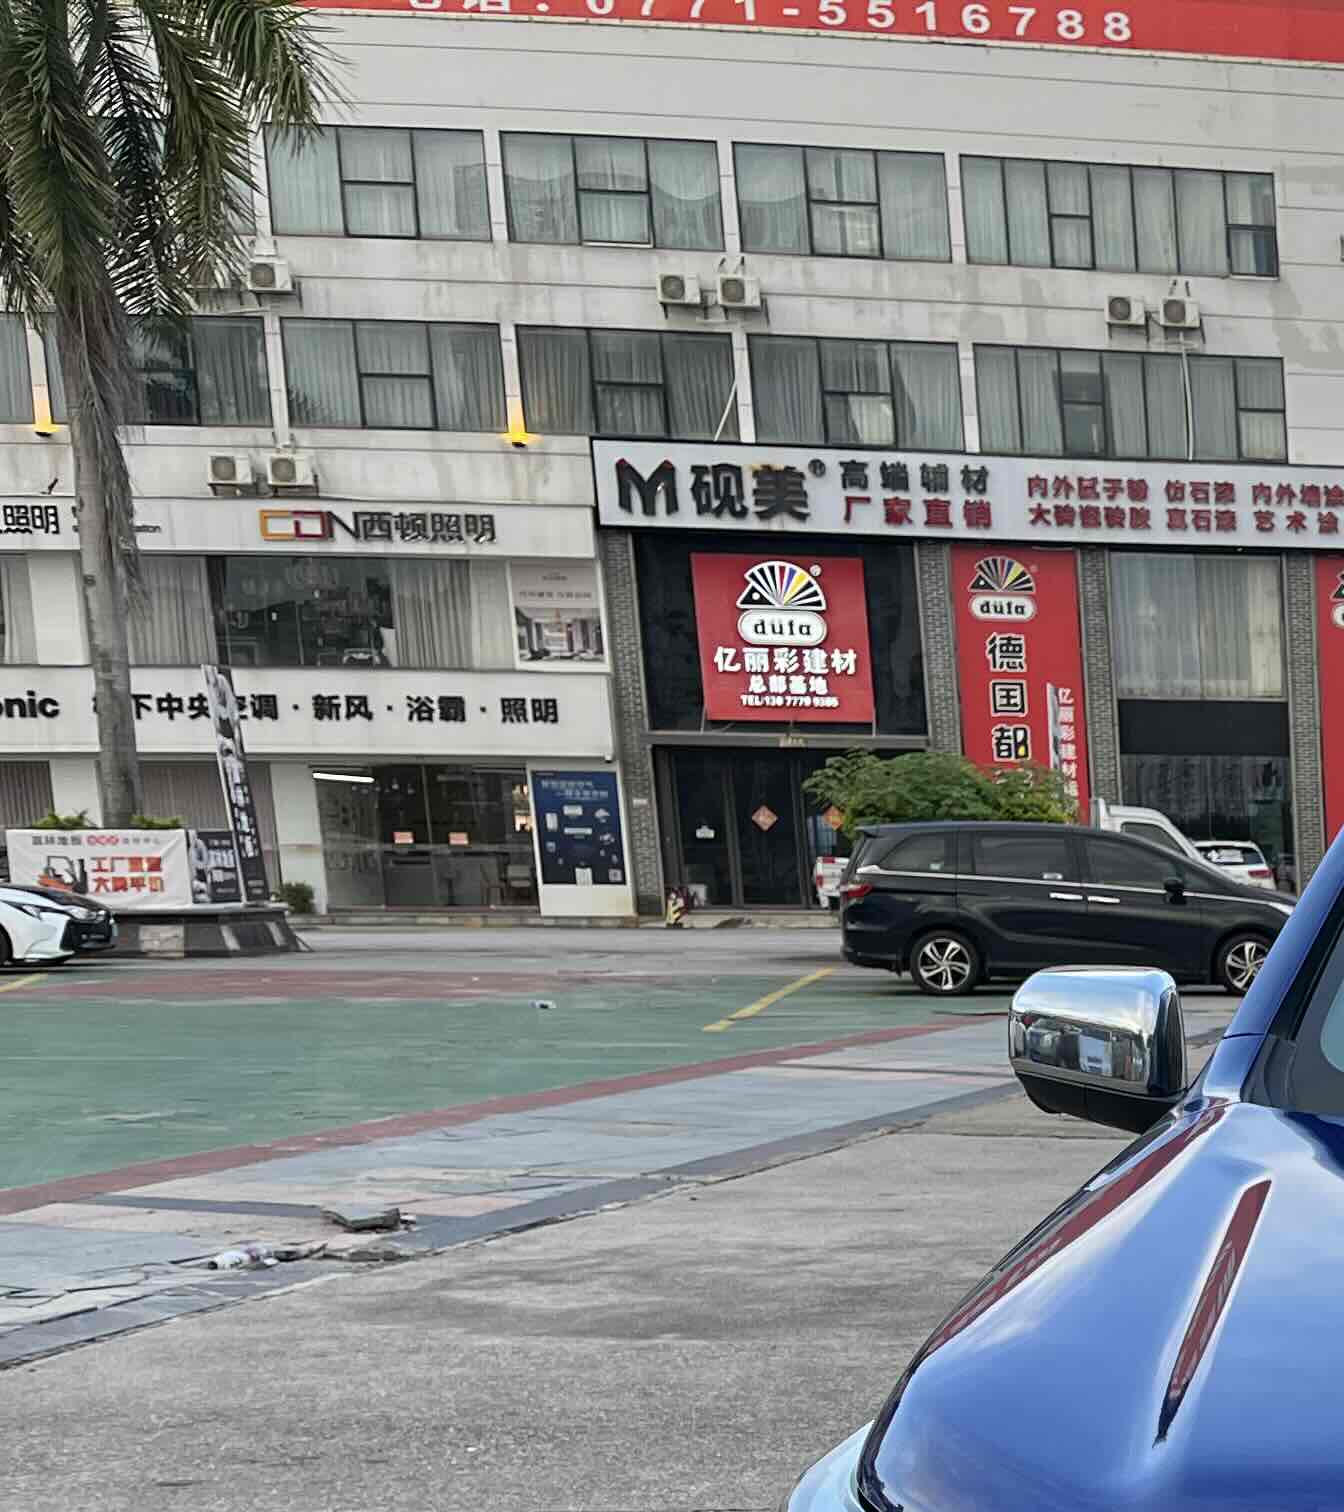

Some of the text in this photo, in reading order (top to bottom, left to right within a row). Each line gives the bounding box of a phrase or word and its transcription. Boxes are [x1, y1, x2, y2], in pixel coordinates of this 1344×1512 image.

[689, 460, 812, 523] 砚美
[0, 504, 61, 534] 照明
[843, 495, 993, 530] 厂家直销
[713, 646, 857, 674] 亿丽彩建材
[0, 690, 60, 718] nic
[986, 632, 1033, 788] 德国都
